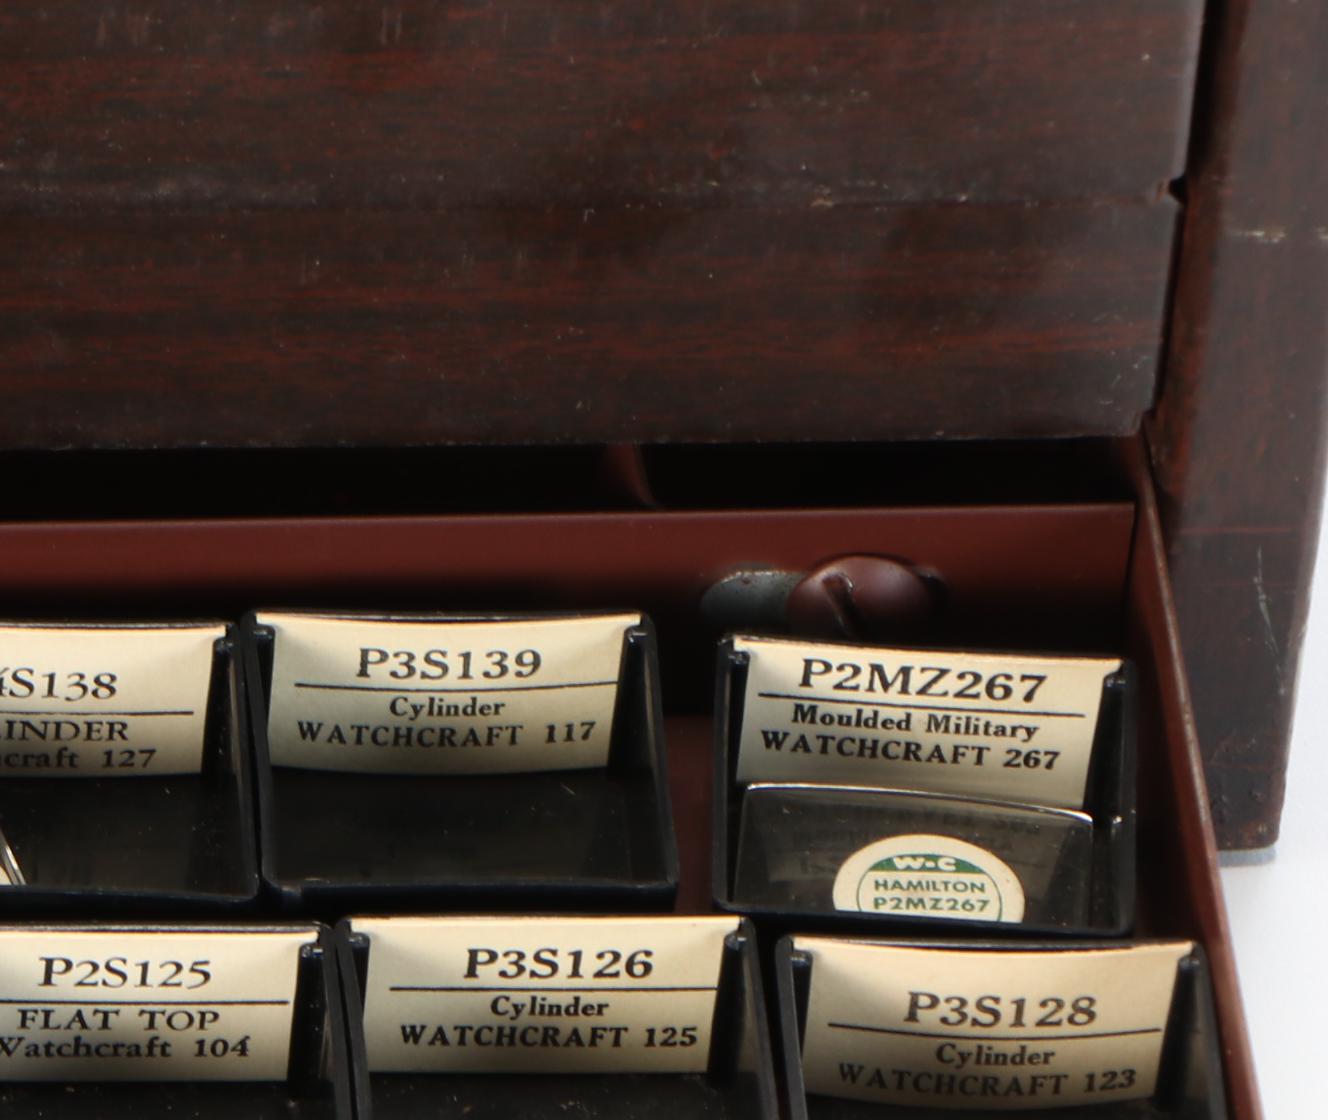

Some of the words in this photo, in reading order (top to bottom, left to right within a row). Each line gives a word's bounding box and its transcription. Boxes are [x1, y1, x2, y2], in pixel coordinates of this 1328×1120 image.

[357, 649, 541, 680] P3S139
[799, 659, 1046, 703] P2MZ267
[390, 697, 505, 721] Cylinder
[298, 721, 523, 747] WATCHCRAFT
[546, 722, 595, 743] 117
[792, 703, 911, 731] Moulded
[926, 714, 1039, 742] Military
[103, 749, 156, 768] 127
[874, 880, 986, 893] HAMILTON
[873, 897, 990, 912] P2MZ267
[39, 957, 210, 988] P2S125
[464, 949, 652, 979] P3S126
[18, 1009, 120, 1030] FLAT
[138, 1010, 219, 1030] TOP
[491, 996, 609, 1020] Cylinder
[904, 992, 1096, 1027] P3S128
[195, 1036, 250, 1057] 104
[936, 1043, 1055, 1069] Cylinder
[840, 1064, 1068, 1096] WATCHCRAFT
[1085, 1069, 1136, 1092] 123
